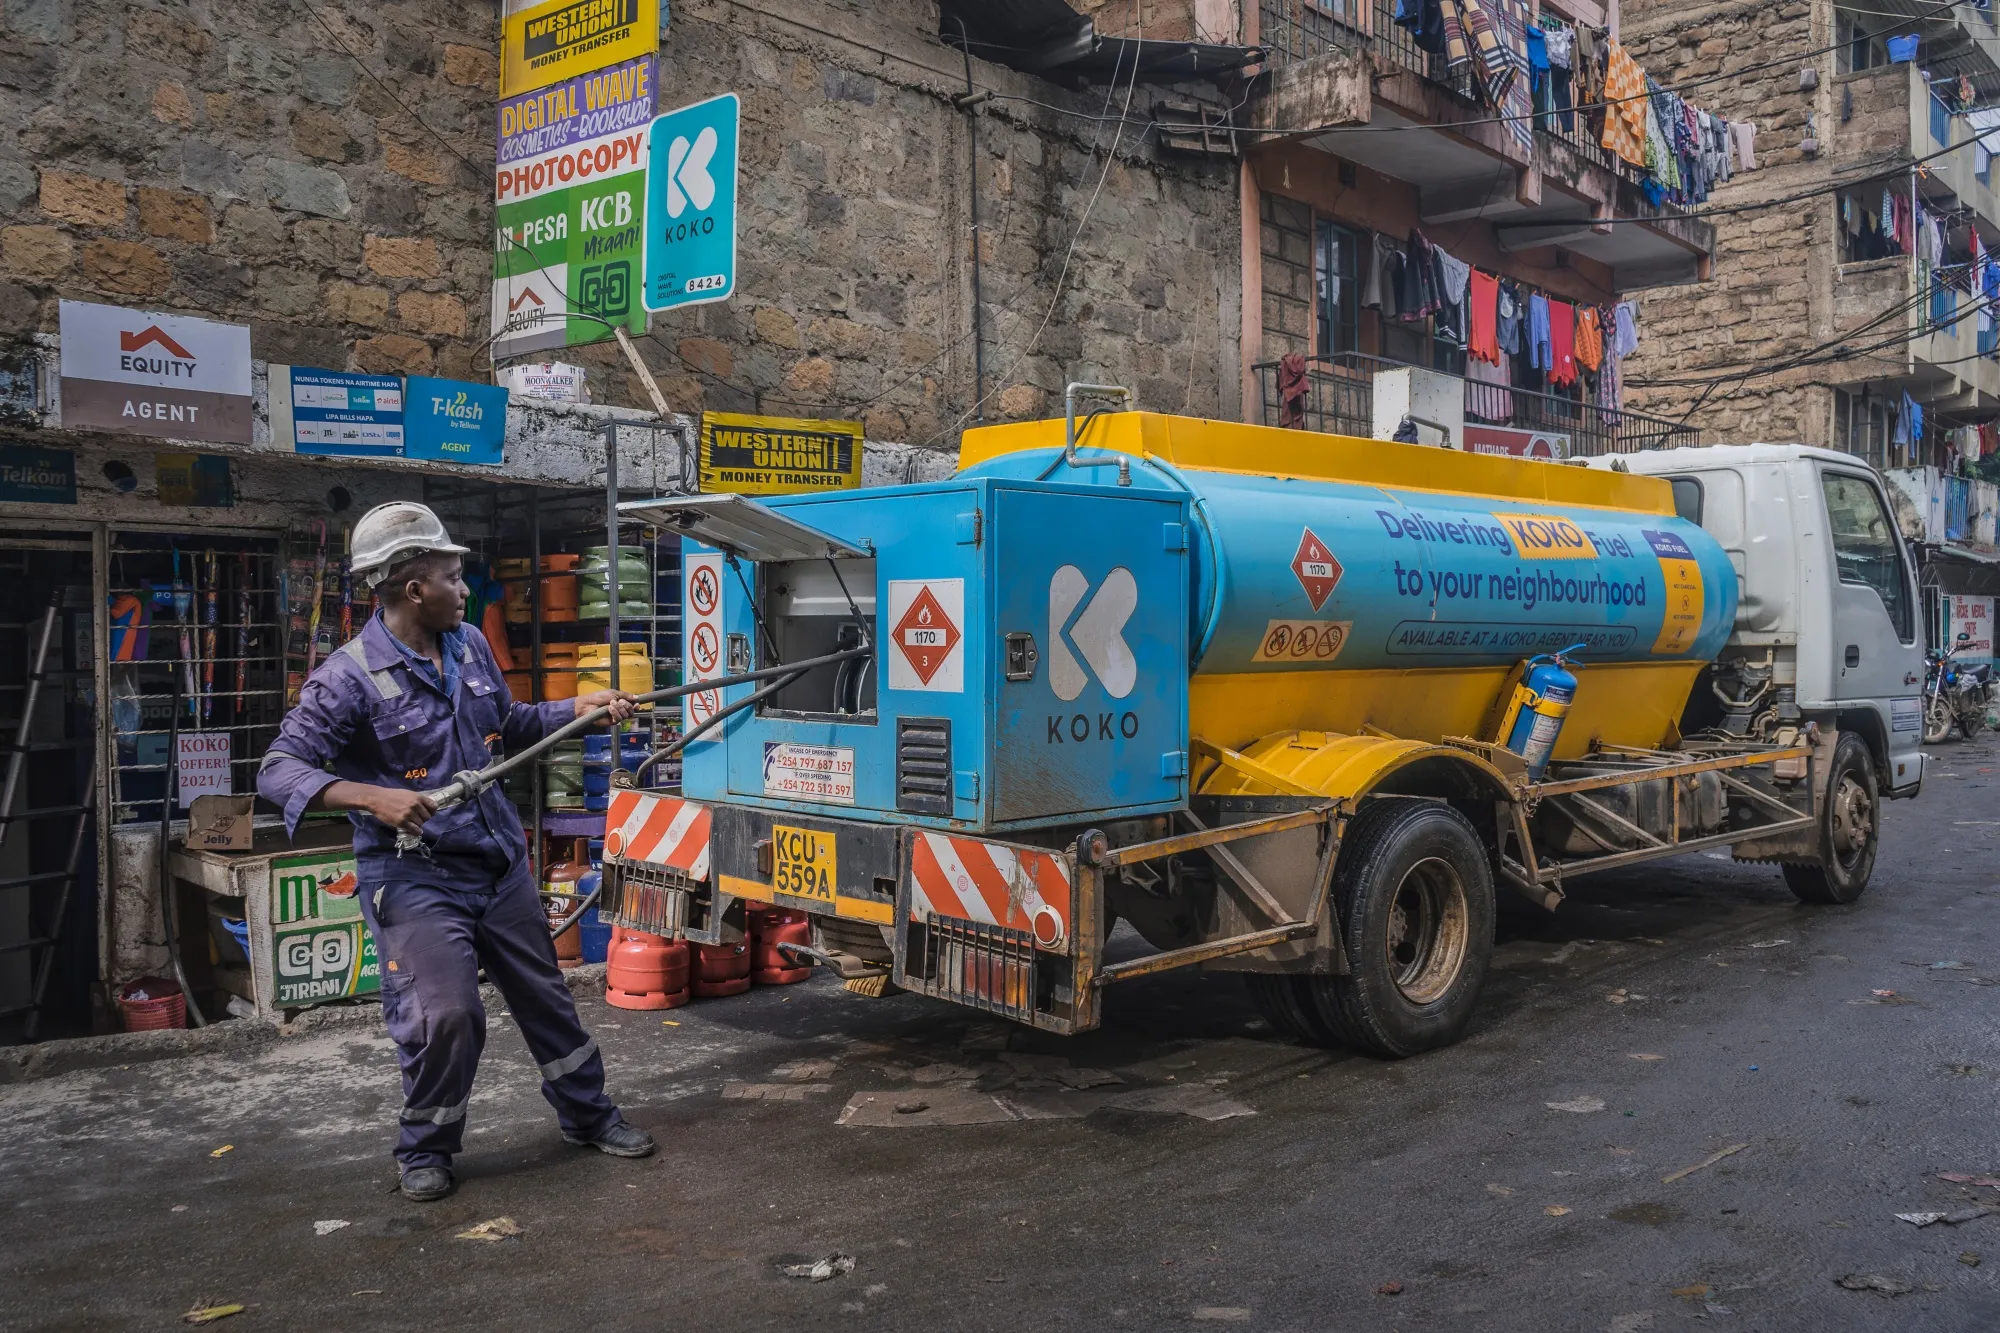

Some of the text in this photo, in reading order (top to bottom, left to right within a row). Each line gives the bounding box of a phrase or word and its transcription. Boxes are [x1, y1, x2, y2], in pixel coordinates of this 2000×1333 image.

[528, 0, 613, 39] WESTERN
[556, 10, 613, 46] UNION
[531, 28, 630, 70] MONEY TRANSFER
[502, 61, 648, 138] DIGITAL WAVE
[497, 132, 644, 199] PHOTOCOPY
[580, 191, 633, 232] KCB
[665, 216, 714, 245] KOKO
[658, 272, 676, 281] DIGITAL
[689, 276, 722, 291] 8424
[657, 288, 684, 299] SOLUTIONS
[658, 281, 673, 290] WAVE
[508, 307, 545, 332] EQUITY
[120, 355, 197, 378] EQUITY
[294, 375, 319, 383] NUNUA
[319, 377, 344, 385] TOKENS
[524, 376, 574, 386] MOONWALKER
[383, 397, 399, 405] airtel
[431, 397, 483, 420] T-kash
[122, 400, 199, 423] AGENT
[450, 420, 480, 430] by Telkom
[441, 442, 471, 452] AGENT
[715, 430, 822, 452] WESTERN
[753, 451, 822, 469] UNION
[0, 464, 67, 486] Telkom
[720, 471, 843, 485] MONEY TRANSFER
[1375, 510, 1635, 558] Delivering KOKO Fuel
[1654, 543, 1689, 554] KOKO FUEL
[1309, 563, 1326, 576] 1170
[1316, 585, 1321, 595] 3
[1394, 560, 1646, 610] to your neighbourhood
[914, 630, 936, 644] 1170
[1397, 630, 1631, 647] AVAILABLE AT A KOKO AGENT NEAR YOU
[922, 655, 928, 666] 3
[1047, 711, 1139, 744] KOKO
[180, 737, 229, 753] KOKO
[812, 749, 838, 757] EMERGENCY
[180, 757, 231, 770] OFFER!!
[776, 756, 852, 772] +254 797 687 157
[180, 774, 232, 788] 2021/=
[811, 773, 832, 781] SPEEDING
[778, 779, 798, 790] +254
[800, 781, 815, 792] 722
[817, 783, 832, 794] 512
[835, 785, 851, 796] 597
[203, 835, 233, 845] Jelly
[775, 830, 816, 864] KCU
[777, 861, 830, 899] 559A
[281, 978, 340, 1001] JIRANI
